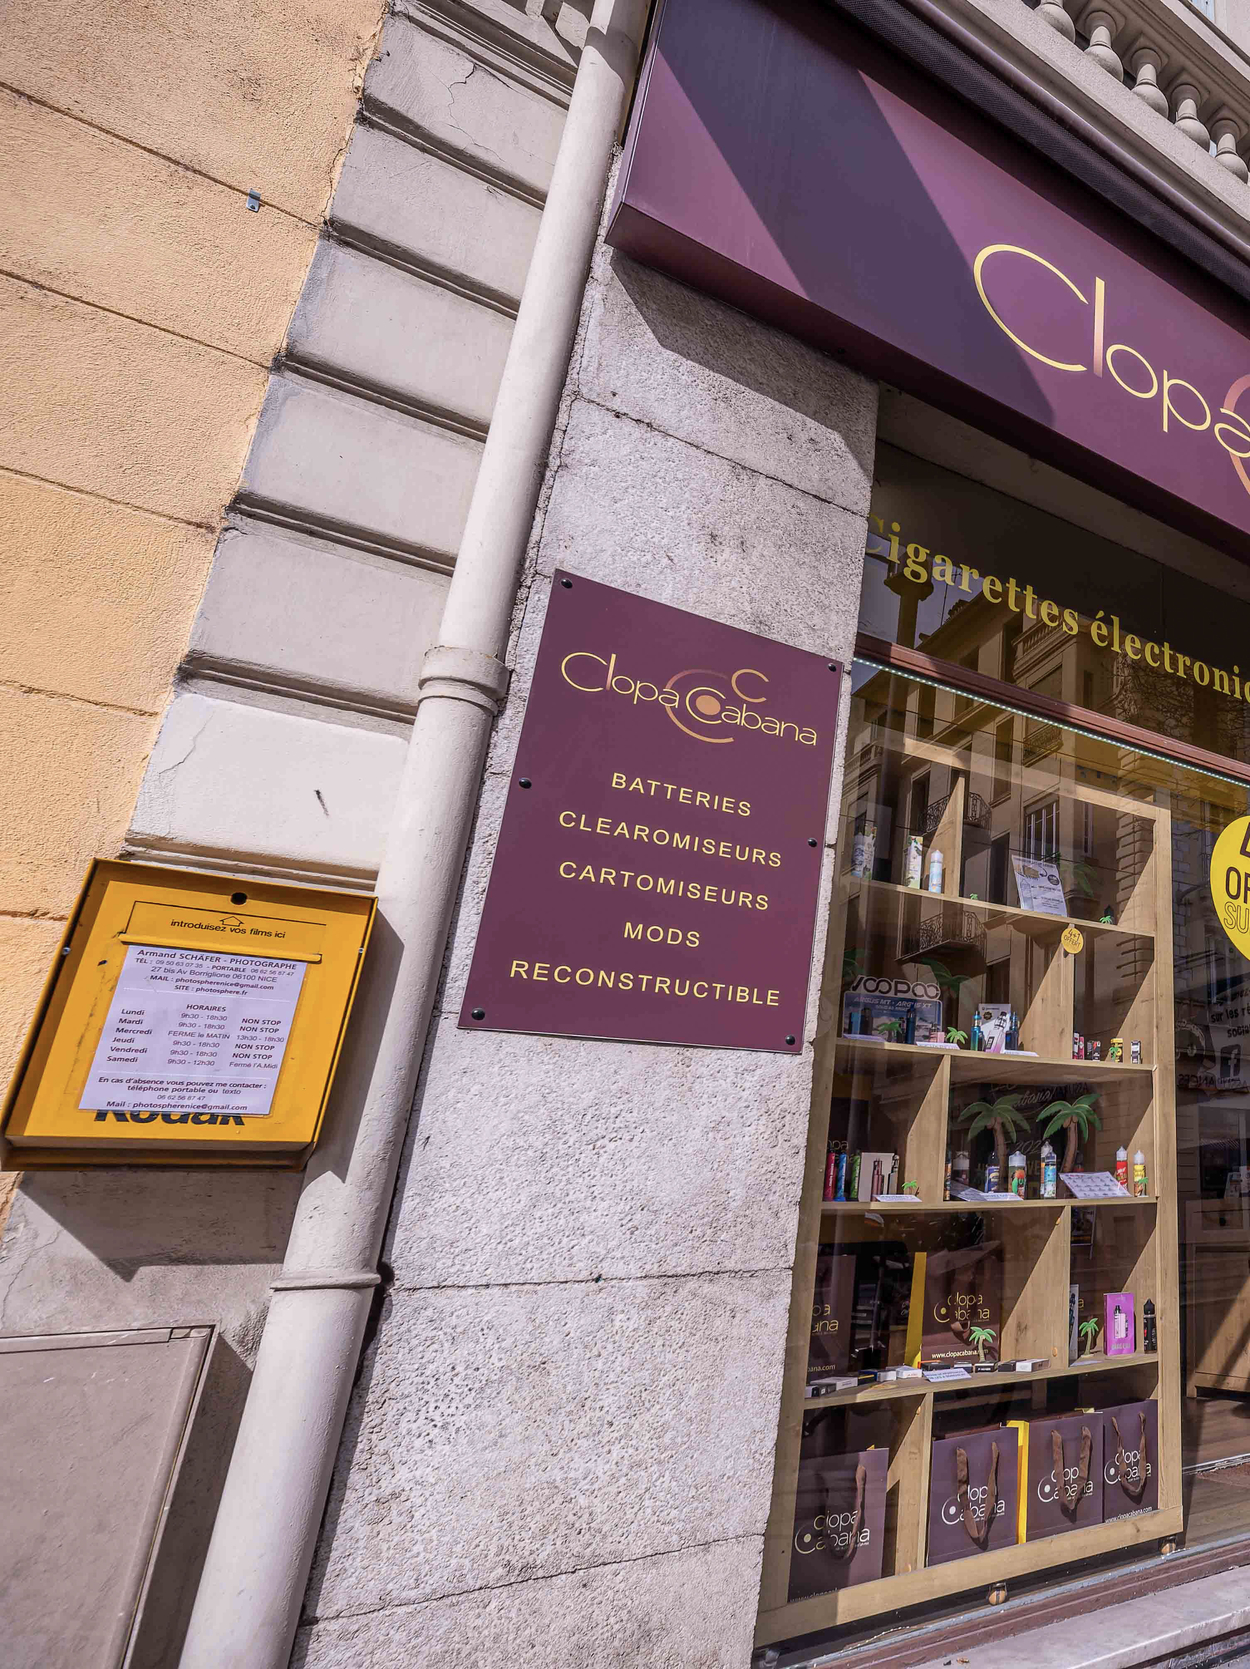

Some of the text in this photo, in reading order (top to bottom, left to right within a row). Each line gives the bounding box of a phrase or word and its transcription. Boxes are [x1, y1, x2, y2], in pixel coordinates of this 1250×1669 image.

[611, 772, 751, 816] BATTERIES
[558, 810, 782, 867] CLEAROMISEURS
[558, 861, 769, 910] CARTOMISEURS
[171, 919, 226, 932] introduisez
[230, 926, 246, 934] vos
[250, 928, 272, 937] films
[623, 921, 700, 947] MODS
[137, 950, 176, 959] Armand
[230, 958, 297, 970] PHOTOGRAPHE
[189, 969, 231, 979] Borriglione
[175, 977, 274, 990] photospherenice@gmail.com
[510, 960, 780, 1006] RECONSTRUCTIBLE
[196, 986, 248, 996] photosphere.fr
[186, 1004, 226, 1012] HORAIRES
[116, 1027, 152, 1035] Mercredi
[110, 1046, 147, 1054] Vendredi
[107, 1055, 138, 1063] Samedi
[126, 1077, 164, 1085] d'absence
[128, 1084, 169, 1093] téléphone
[171, 1086, 205, 1094] portable
[133, 1102, 247, 1111] photospherenice@gmail.com
[932, 1349, 988, 1359] www.clopacabana.m
